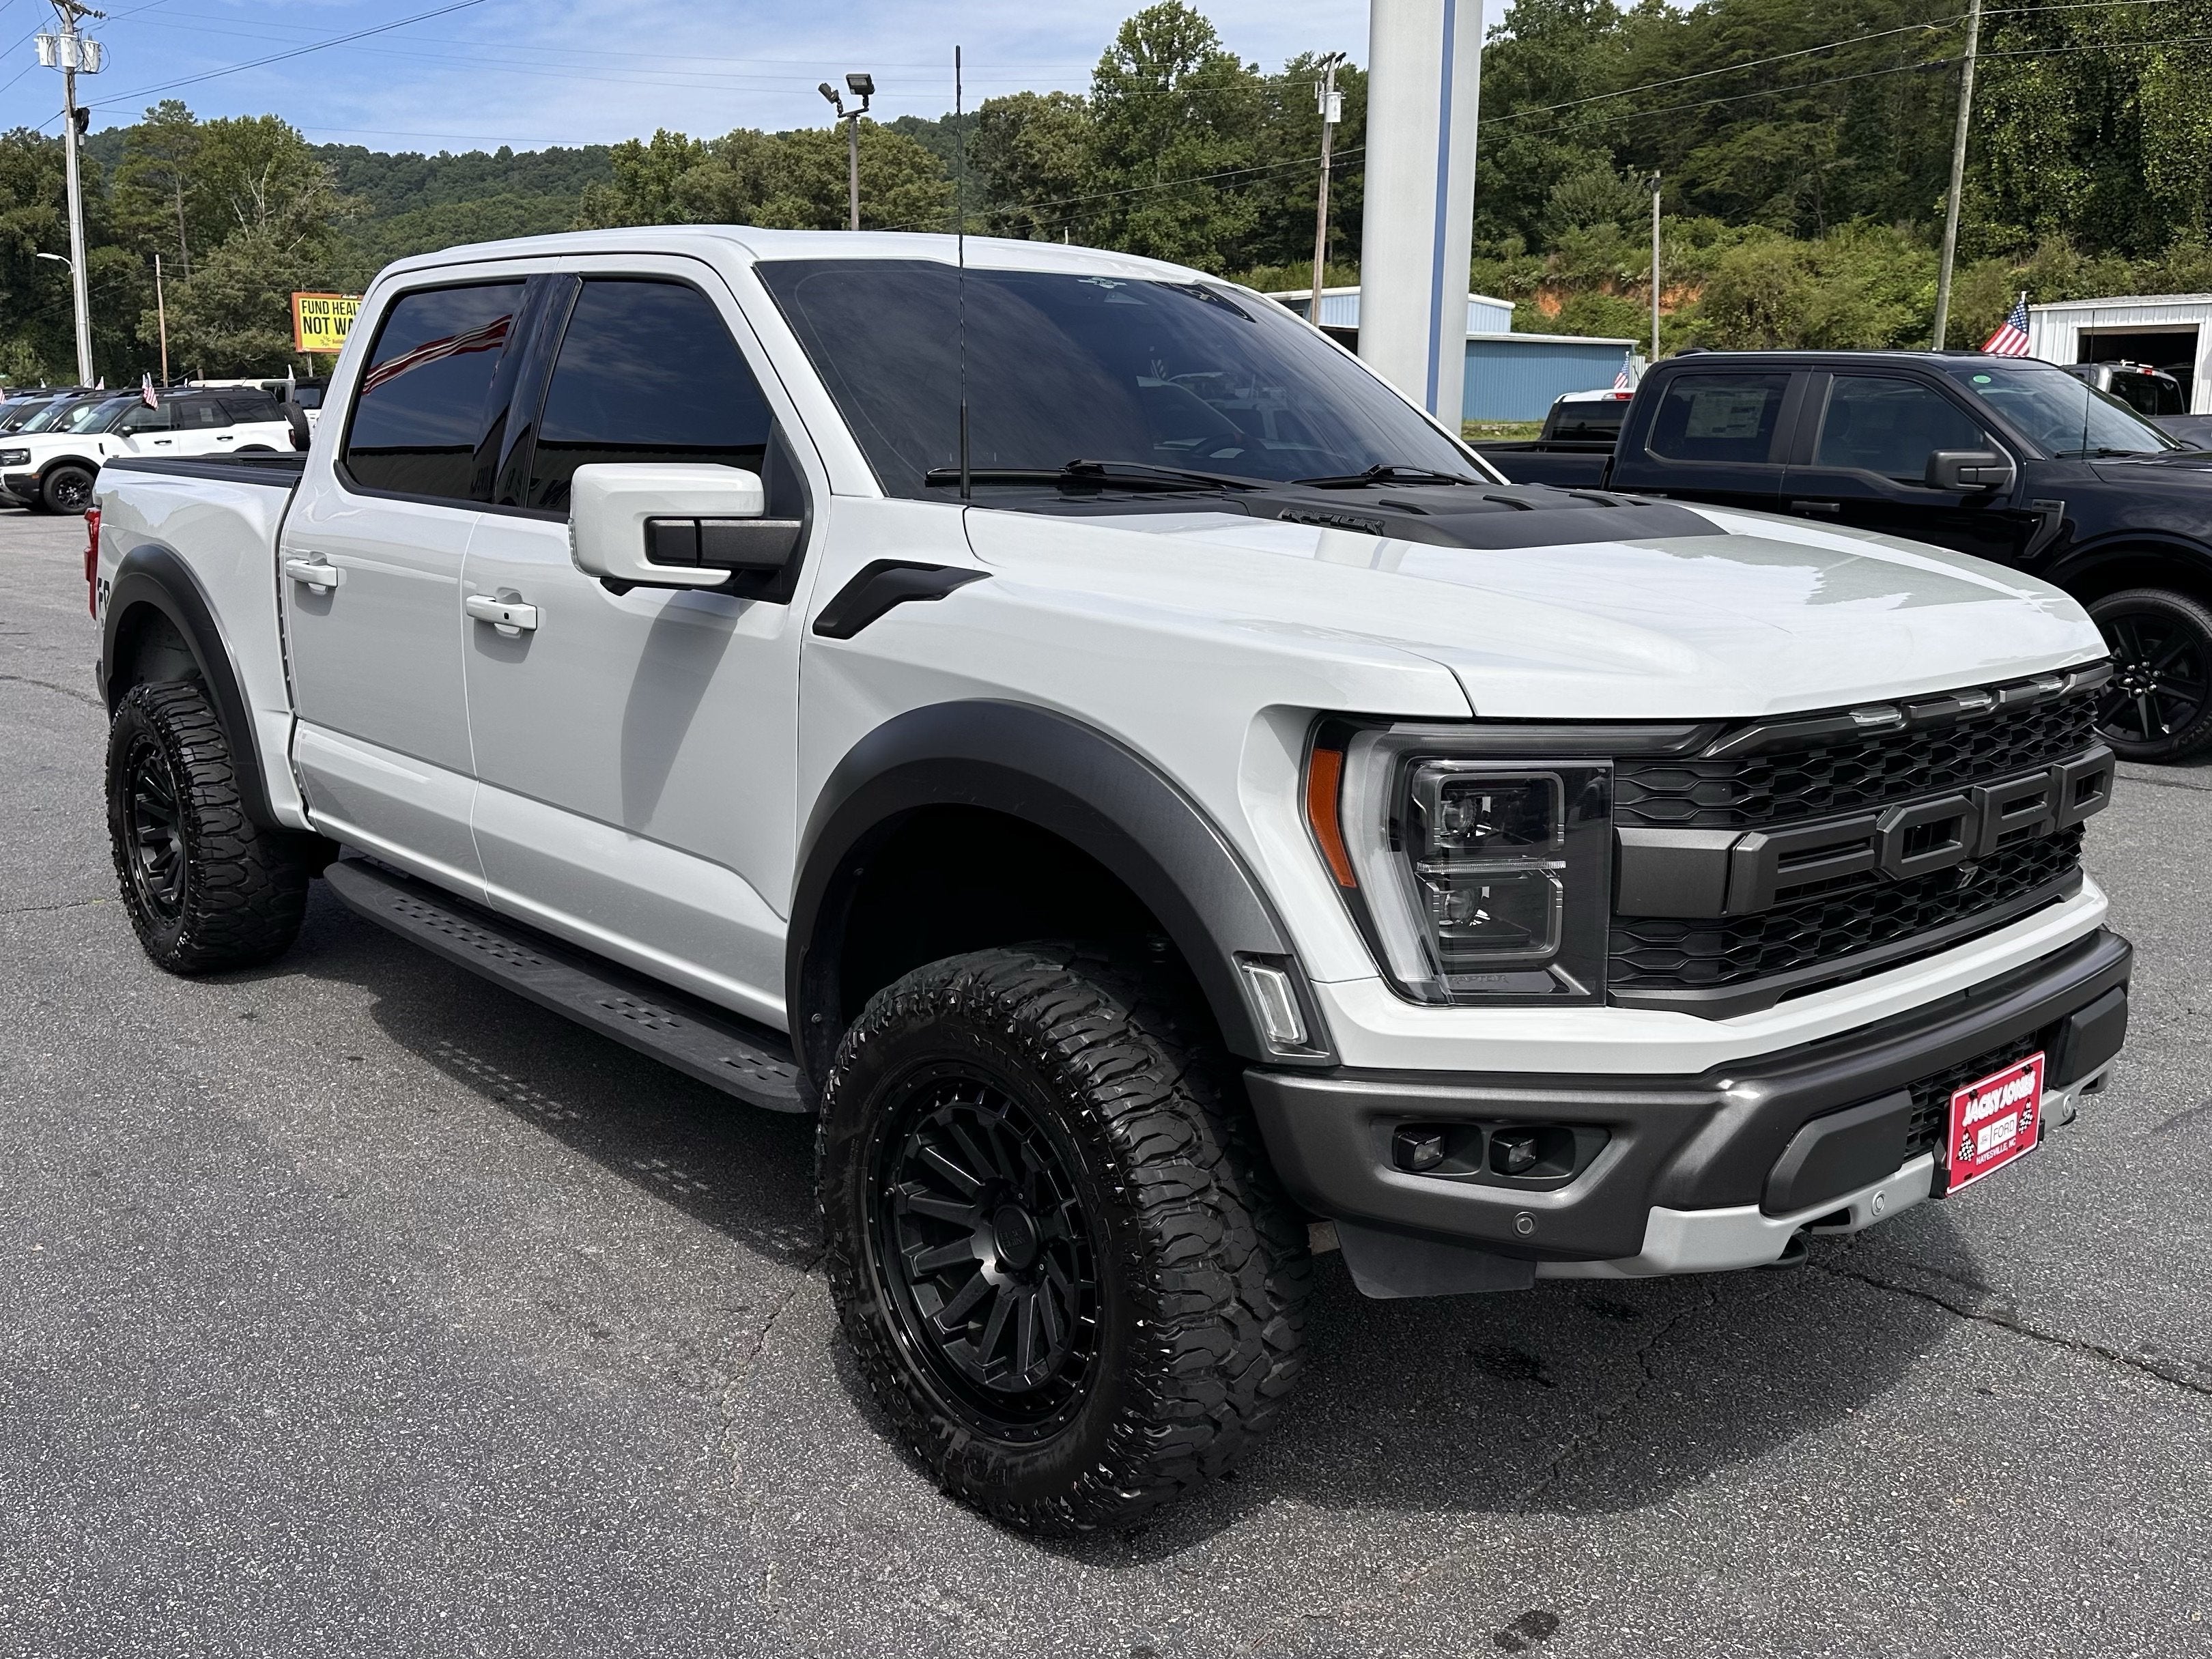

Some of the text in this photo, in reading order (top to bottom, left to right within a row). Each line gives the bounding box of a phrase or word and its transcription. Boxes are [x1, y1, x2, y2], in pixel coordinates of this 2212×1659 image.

[302, 300, 329, 314] FUND
[303, 316, 330, 335] NOT
[1277, 507, 1384, 537] RAPTOR
[1729, 746, 2115, 915] FORD
[1961, 1070, 2036, 1127] JACKY JONES
[1993, 1119, 2015, 1141] FORD
[1976, 1142, 2009, 1166] HAYESVILLE,
[2008, 1137, 2017, 1148] NC
